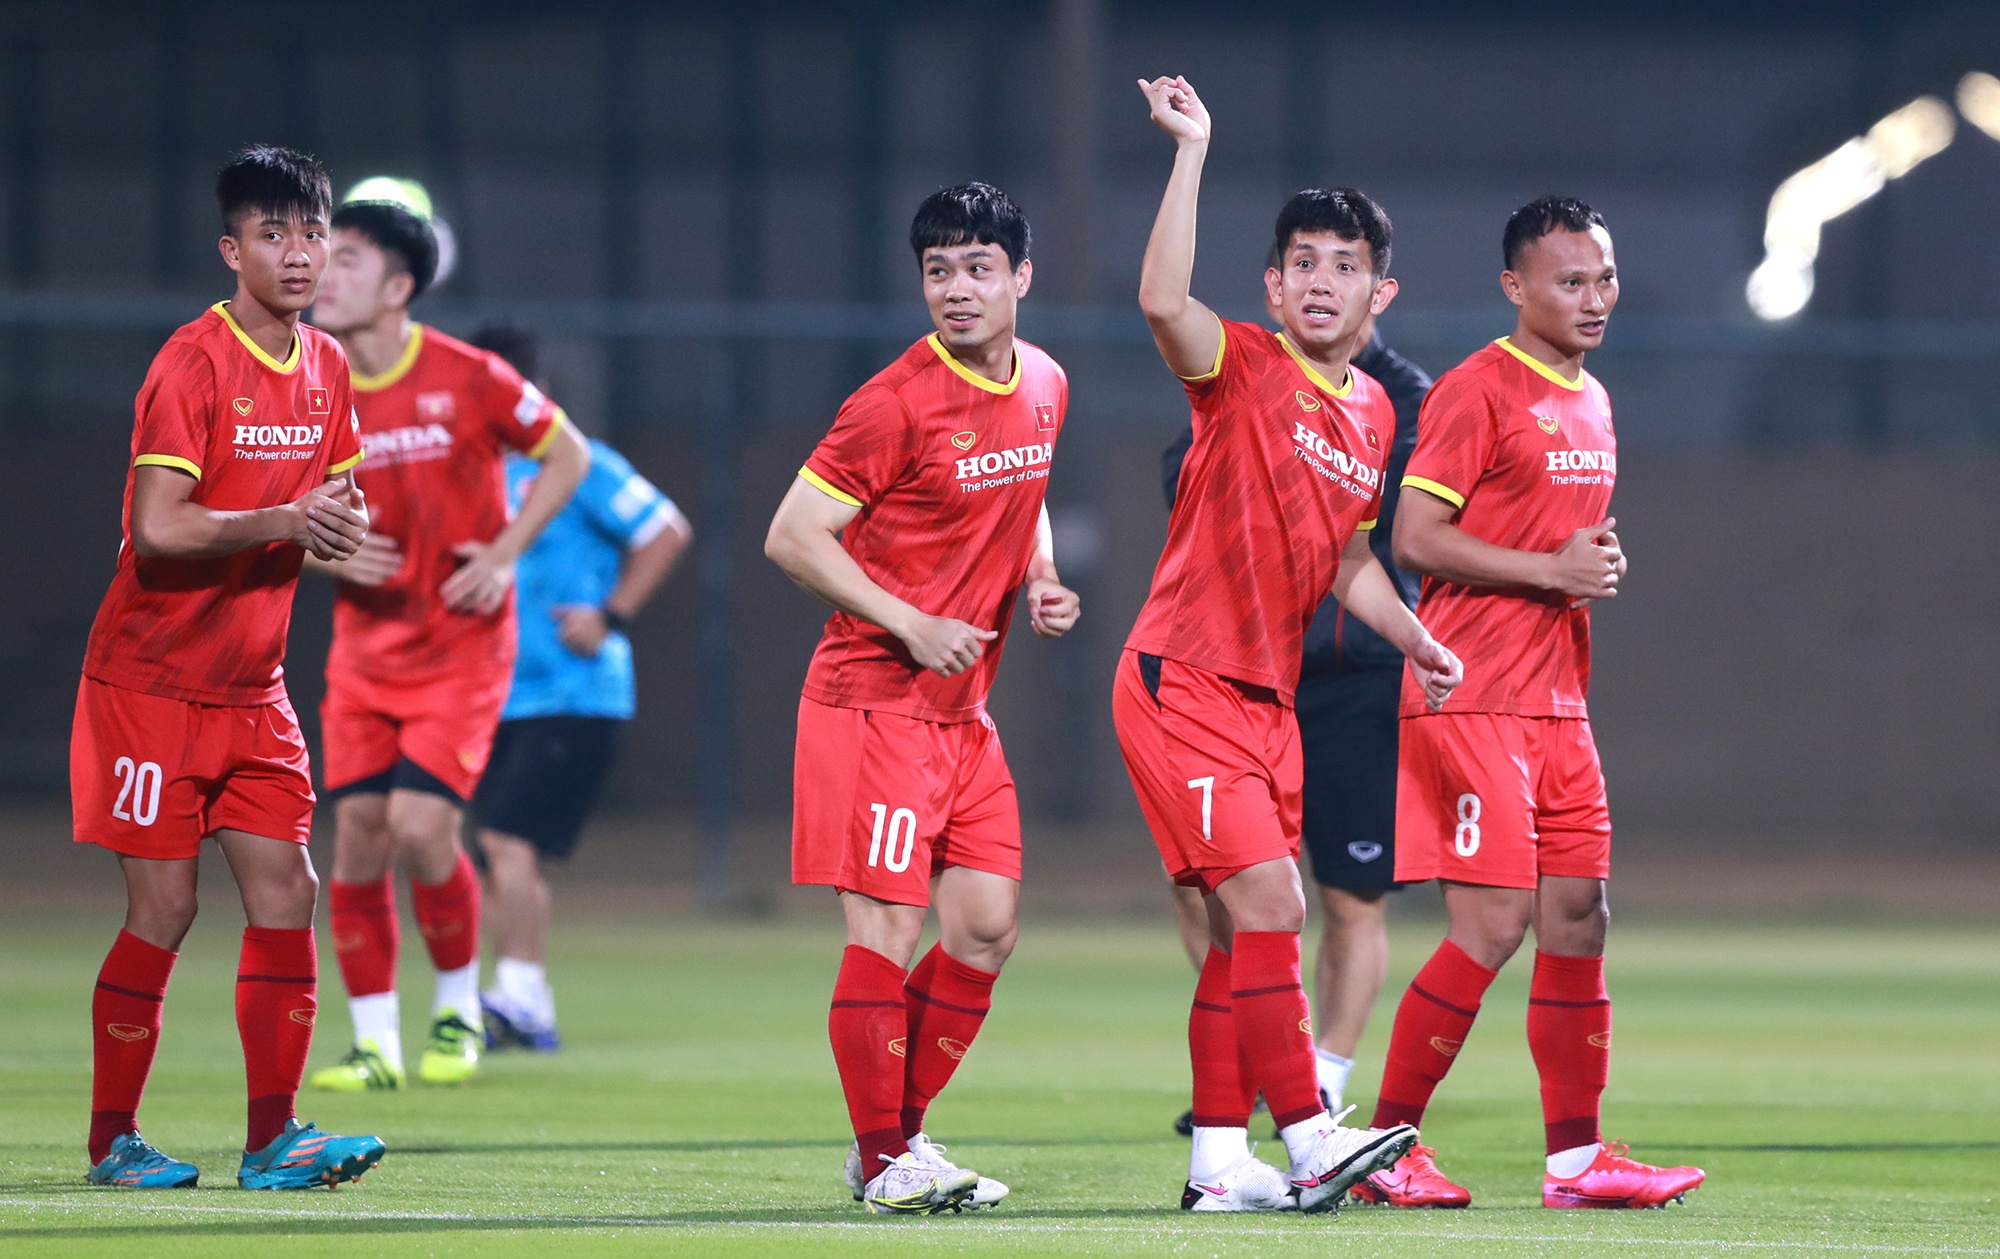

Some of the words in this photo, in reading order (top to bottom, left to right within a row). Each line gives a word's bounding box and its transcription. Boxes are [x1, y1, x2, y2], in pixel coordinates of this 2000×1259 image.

[232, 424, 323, 446] HONDA
[234, 448, 254, 460] The
[254, 449, 279, 461] Power
[281, 448, 291, 460] of
[1292, 421, 1379, 490] HONDA
[955, 442, 1053, 480] HONDA
[960, 481, 981, 494] The
[982, 474, 1015, 490] Power
[1016, 472, 1025, 483] of
[1294, 445, 1312, 465] The
[1312, 458, 1341, 484] Power
[1340, 478, 1351, 490] of
[1550, 475, 1569, 485] The
[1591, 474, 1602, 485] of
[112, 756, 163, 827] 20
[1187, 775, 1215, 841] 7
[868, 802, 917, 873] 10
[1455, 792, 1482, 858] 8
